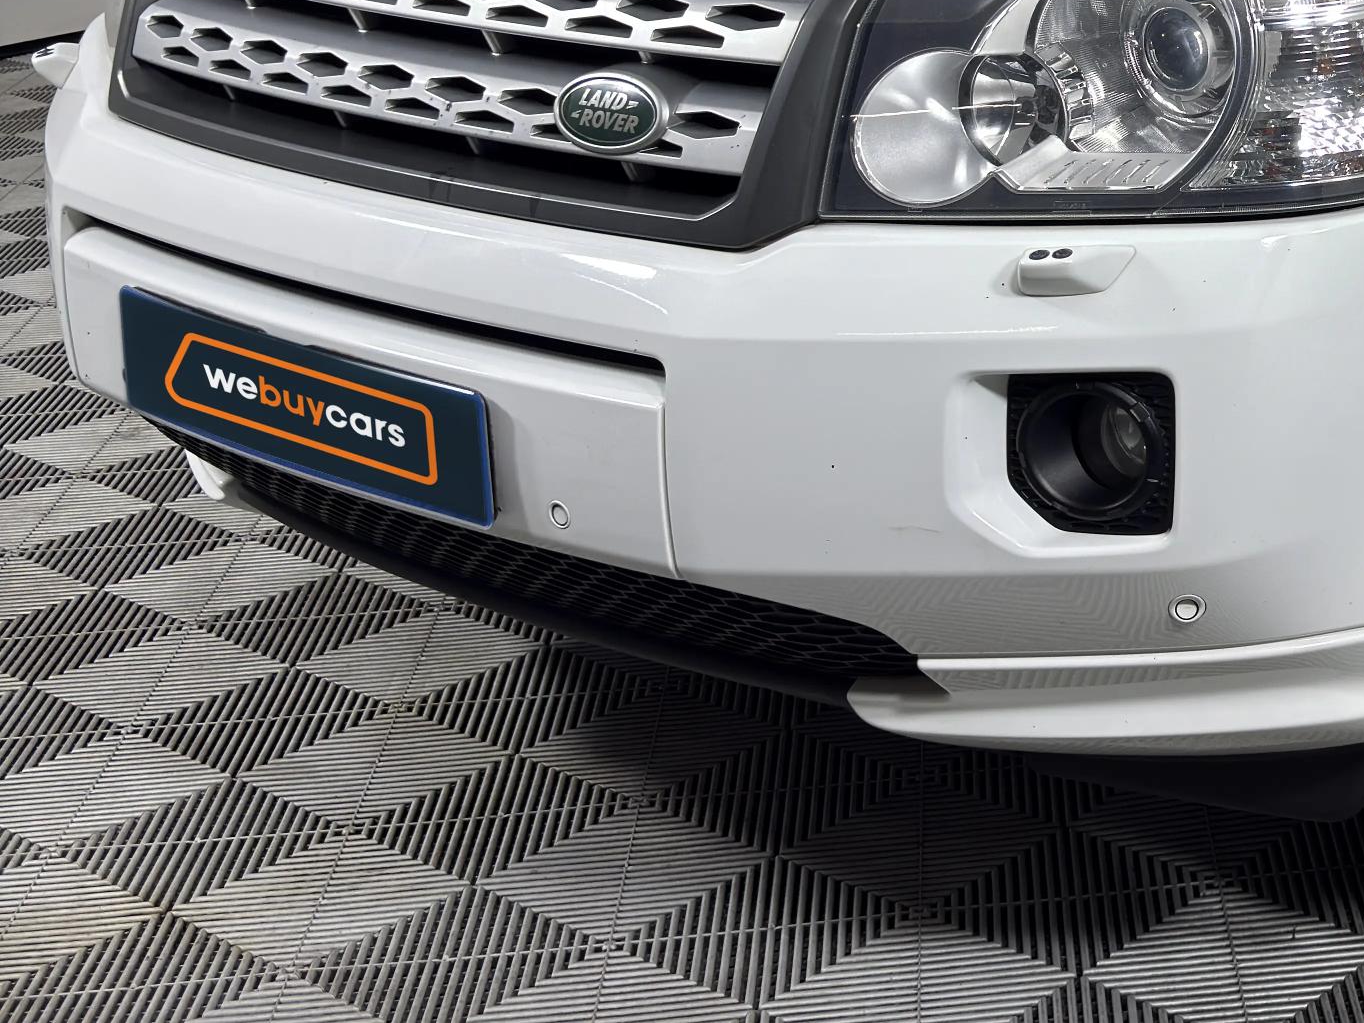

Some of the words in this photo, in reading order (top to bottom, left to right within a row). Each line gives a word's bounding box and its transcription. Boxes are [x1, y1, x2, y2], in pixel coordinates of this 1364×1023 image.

[579, 88, 628, 110] LAND
[579, 109, 639, 134] ROVER
[203, 364, 405, 447] webuycars
